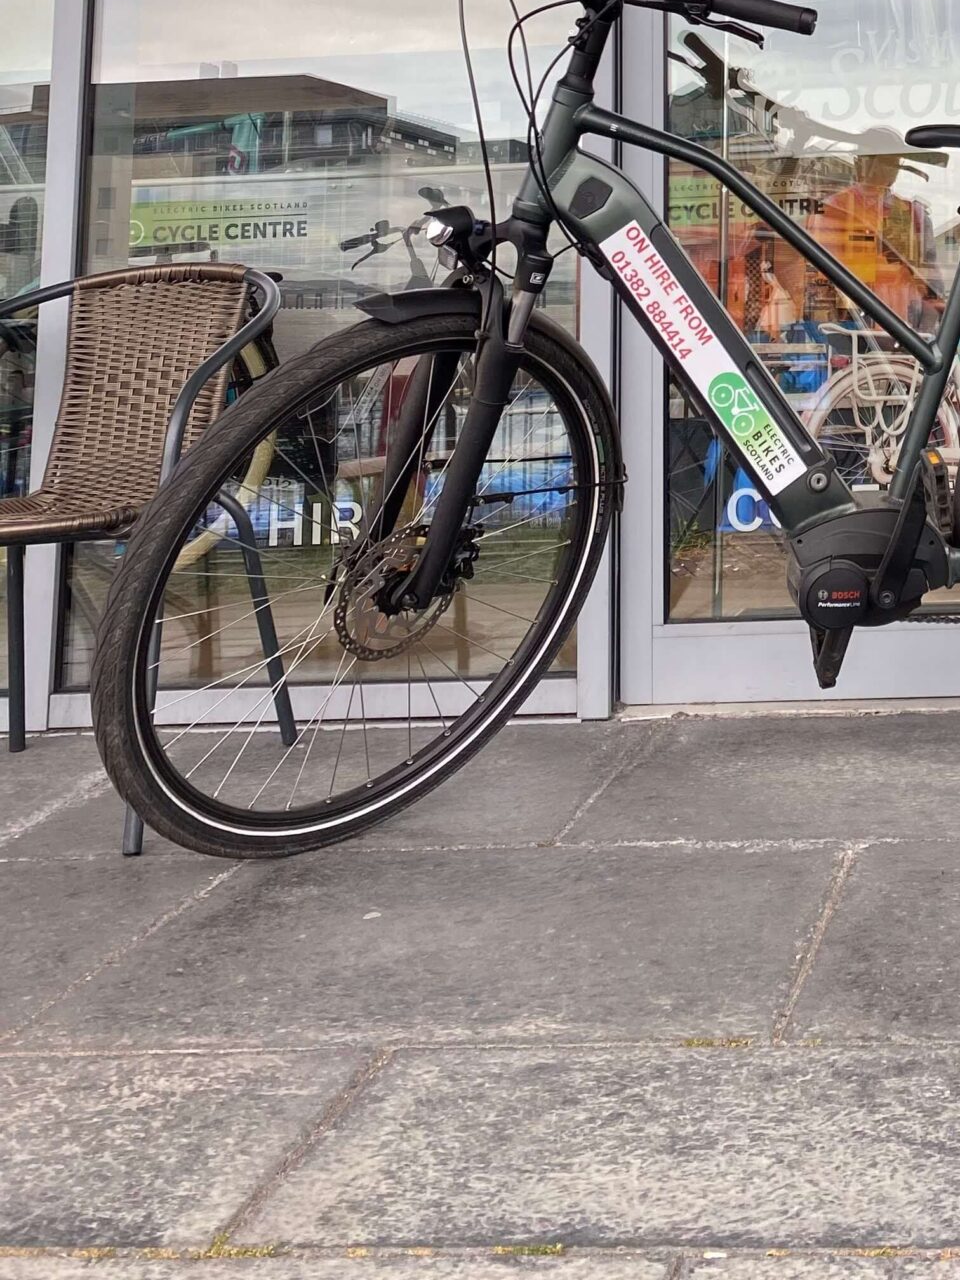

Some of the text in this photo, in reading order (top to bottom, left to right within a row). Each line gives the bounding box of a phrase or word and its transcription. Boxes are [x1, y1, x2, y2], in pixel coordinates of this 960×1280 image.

[251, 201, 308, 210] SCOTLAND
[152, 220, 308, 243] CYCLE CENTRE
[610, 250, 693, 361] 01382 884414
[625, 225, 714, 347] ON HIRE FROM
[742, 439, 775, 481] SCOTLAND
[751, 430, 786, 474] BIKES
[763, 423, 795, 466] ELECTRIC
[831, 591, 860, 600] BOSCH
